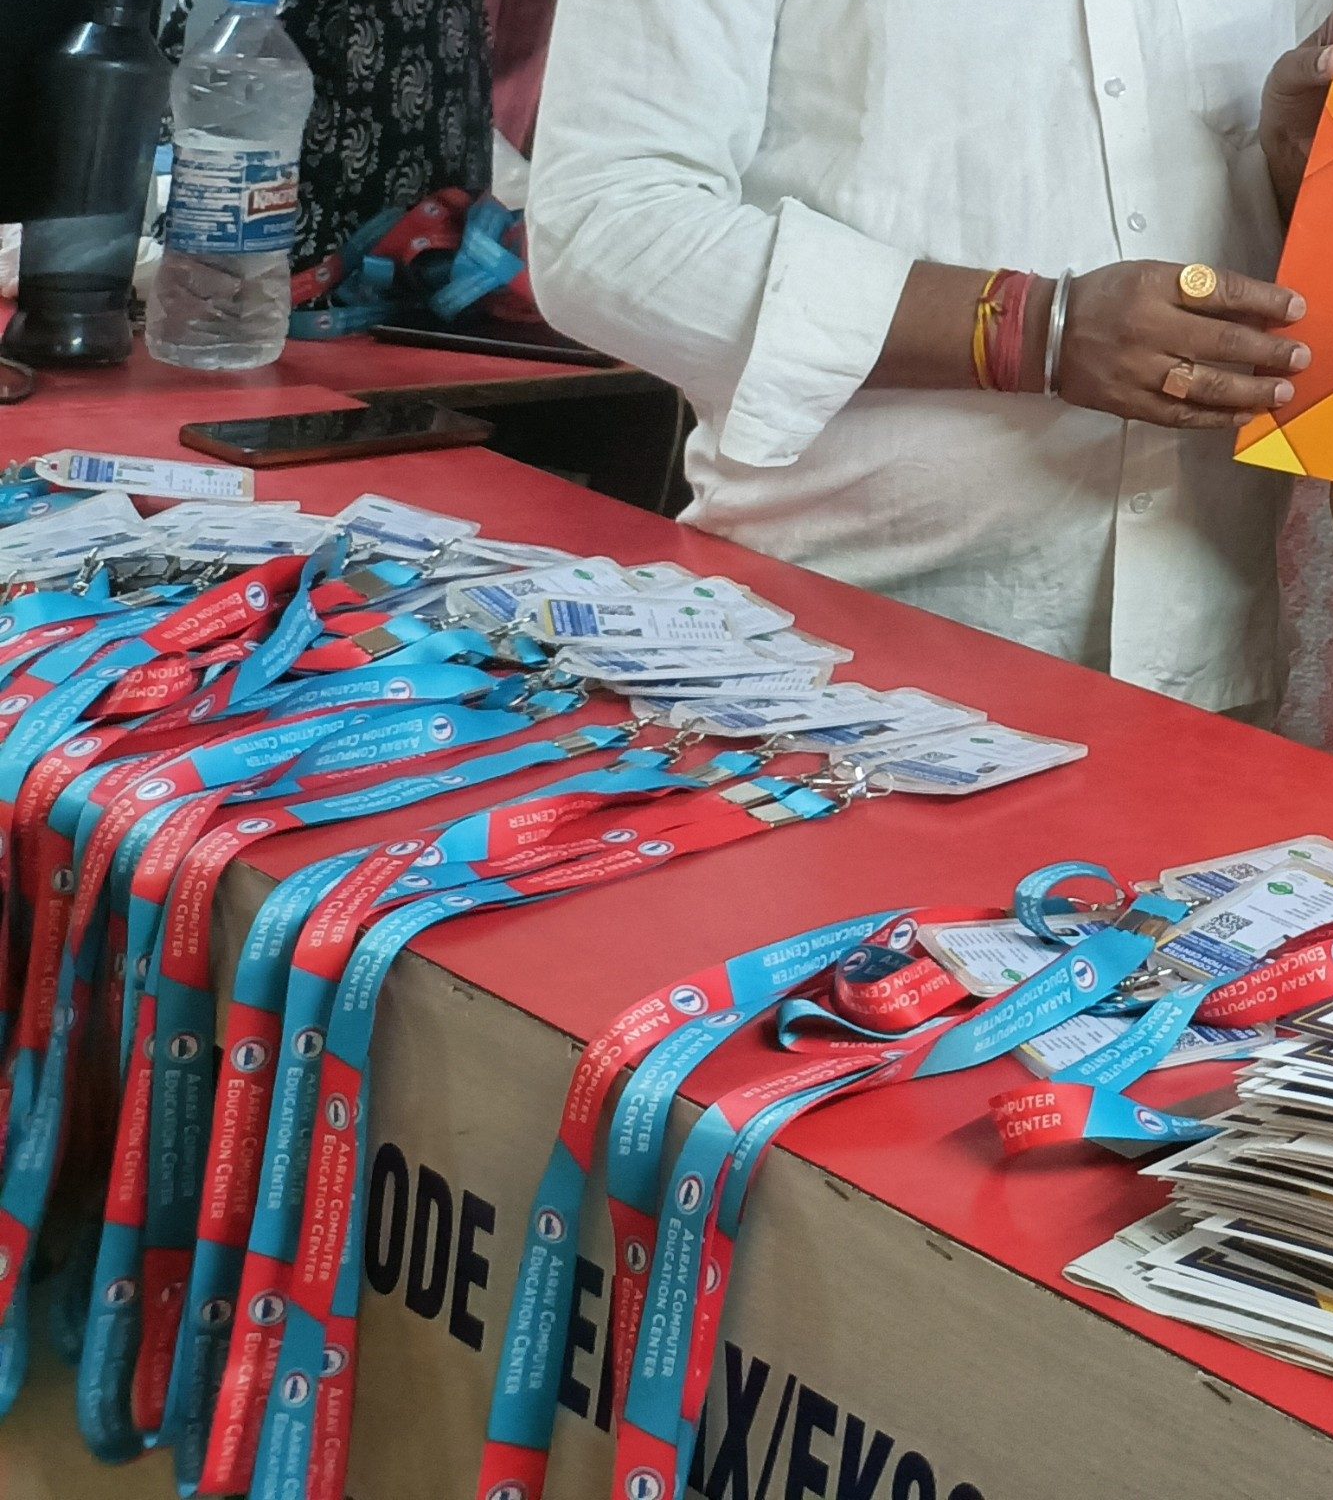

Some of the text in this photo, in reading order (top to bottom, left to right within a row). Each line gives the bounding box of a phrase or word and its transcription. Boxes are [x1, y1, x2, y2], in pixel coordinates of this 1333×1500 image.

[973, 968, 1070, 1036] EDUCATION CENTER
[974, 987, 1072, 1051] AARAV COMPUTER
[1202, 966, 1327, 1019] AARAV COMPUTER
[1251, 946, 1327, 989] EDUCATION
[569, 998, 666, 1122] EDUCATION CENTER
[579, 1012, 670, 1123] AARAV COMPUTER
[619, 1027, 702, 1156] EDUCATION CENTER
[636, 1033, 714, 1153] AARAV COMPUTER
[303, 1134, 337, 1283] EDUCATION CENTER
[319, 1142, 350, 1281] AARAV COMPUTER
[365, 1142, 495, 1351] ODE
